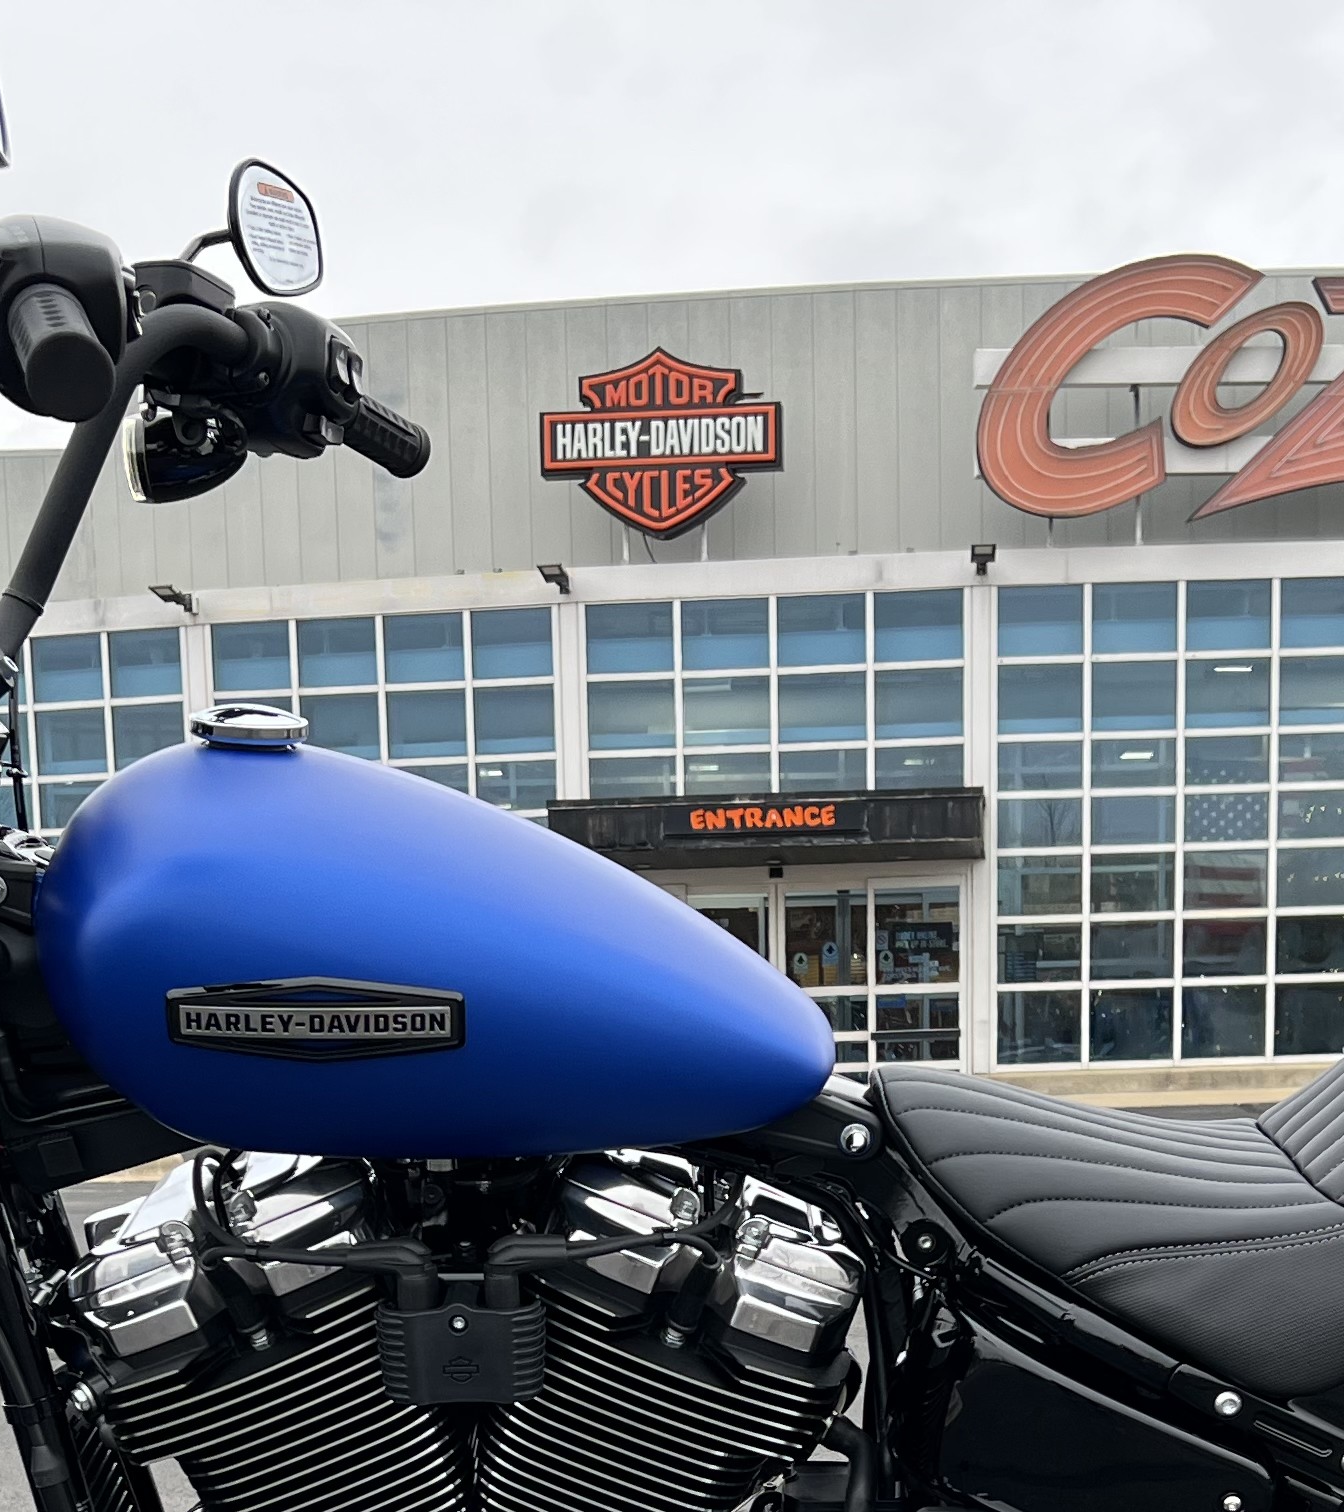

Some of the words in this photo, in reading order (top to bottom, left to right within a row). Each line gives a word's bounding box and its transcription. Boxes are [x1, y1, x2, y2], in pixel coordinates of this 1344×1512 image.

[606, 363, 714, 408] MOTOR
[556, 415, 764, 460] HARLEY-DAVIDSON
[606, 469, 714, 518] CYCLES
[689, 803, 836, 831] ENTRANCE
[184, 1011, 448, 1034] HARLEY-DAVIDSON
